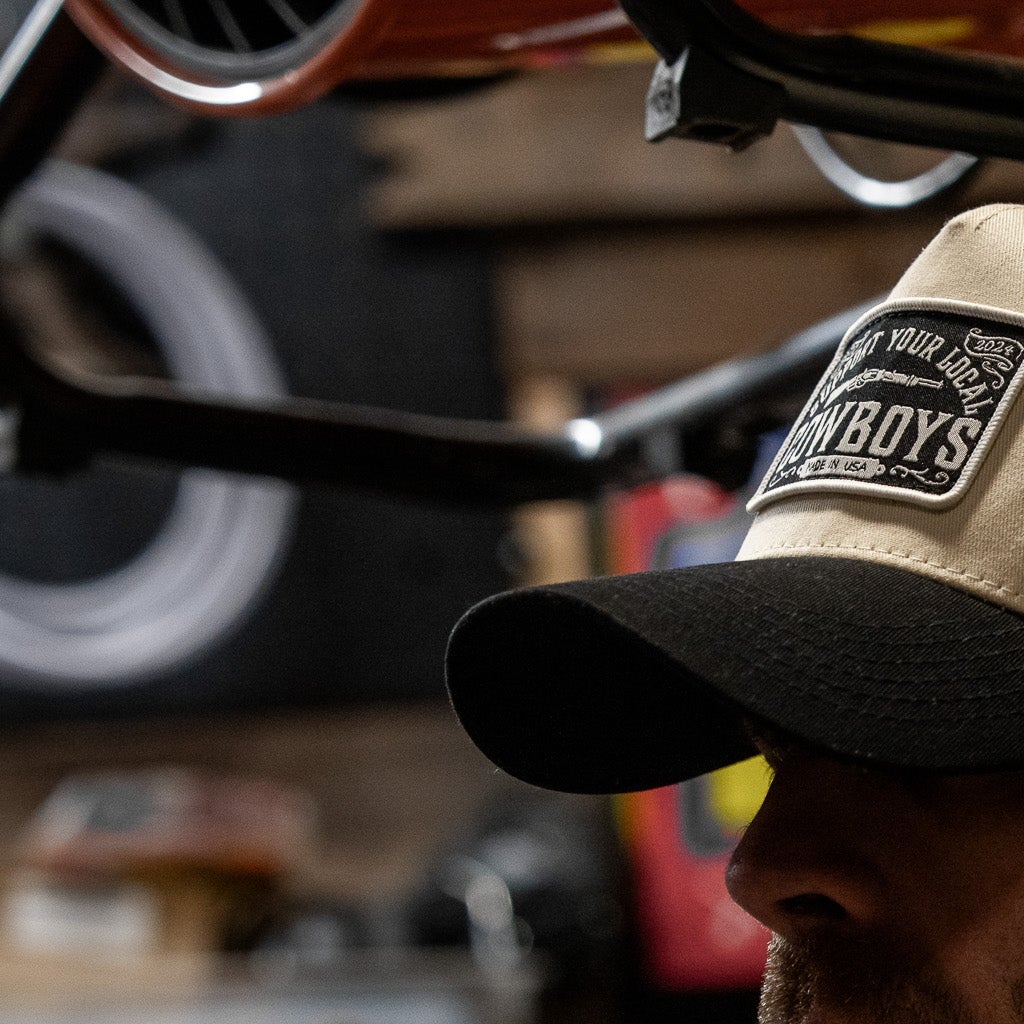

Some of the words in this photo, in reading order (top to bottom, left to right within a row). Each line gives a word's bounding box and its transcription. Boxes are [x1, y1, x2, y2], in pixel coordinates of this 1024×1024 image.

[974, 340, 1015, 356] 2024
[886, 327, 945, 363] YOUR
[936, 346, 994, 415] LOCAL
[775, 400, 982, 474] COWBOYS
[828, 459, 840, 470] IN
[844, 460, 867, 472] USA
